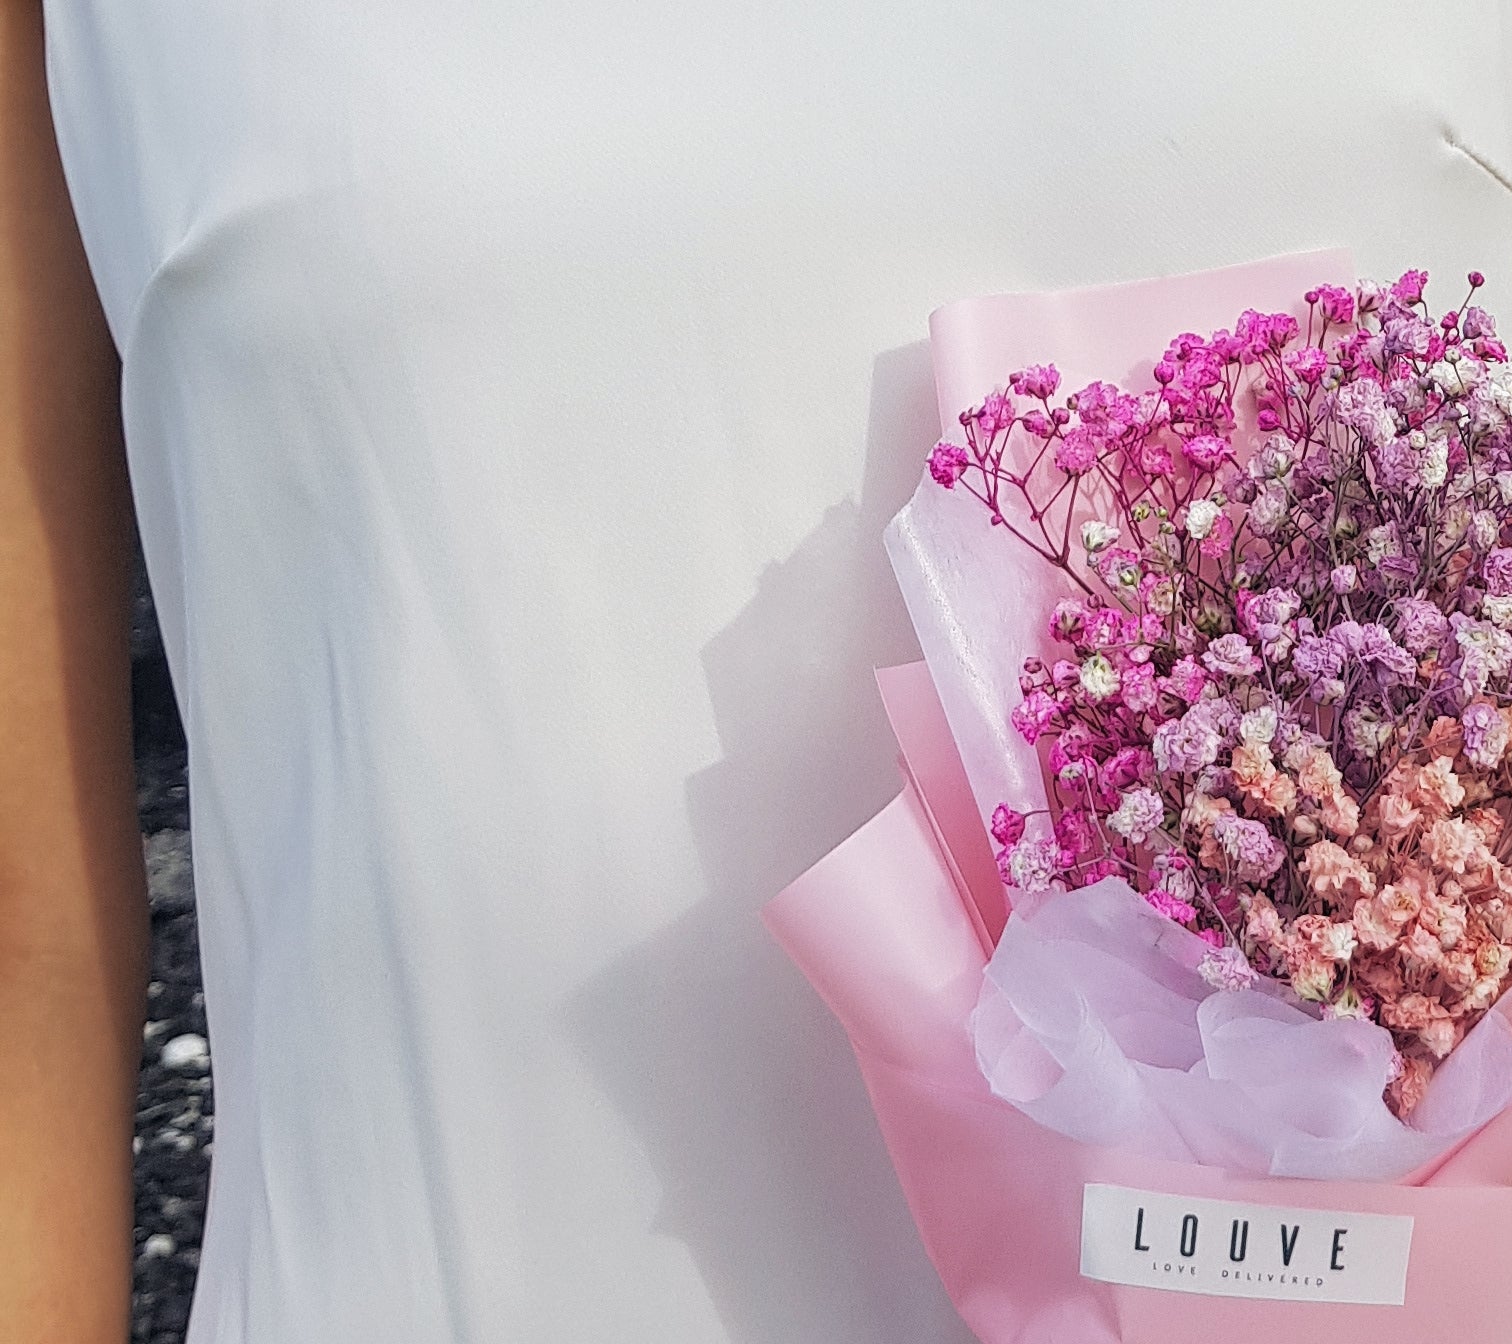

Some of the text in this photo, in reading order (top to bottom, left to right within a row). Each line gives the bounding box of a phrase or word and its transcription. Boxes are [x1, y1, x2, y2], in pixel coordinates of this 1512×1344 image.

[1134, 1207, 1348, 1271] LOUVE
[1152, 1262, 1324, 1287] LOVE DELIVERED
